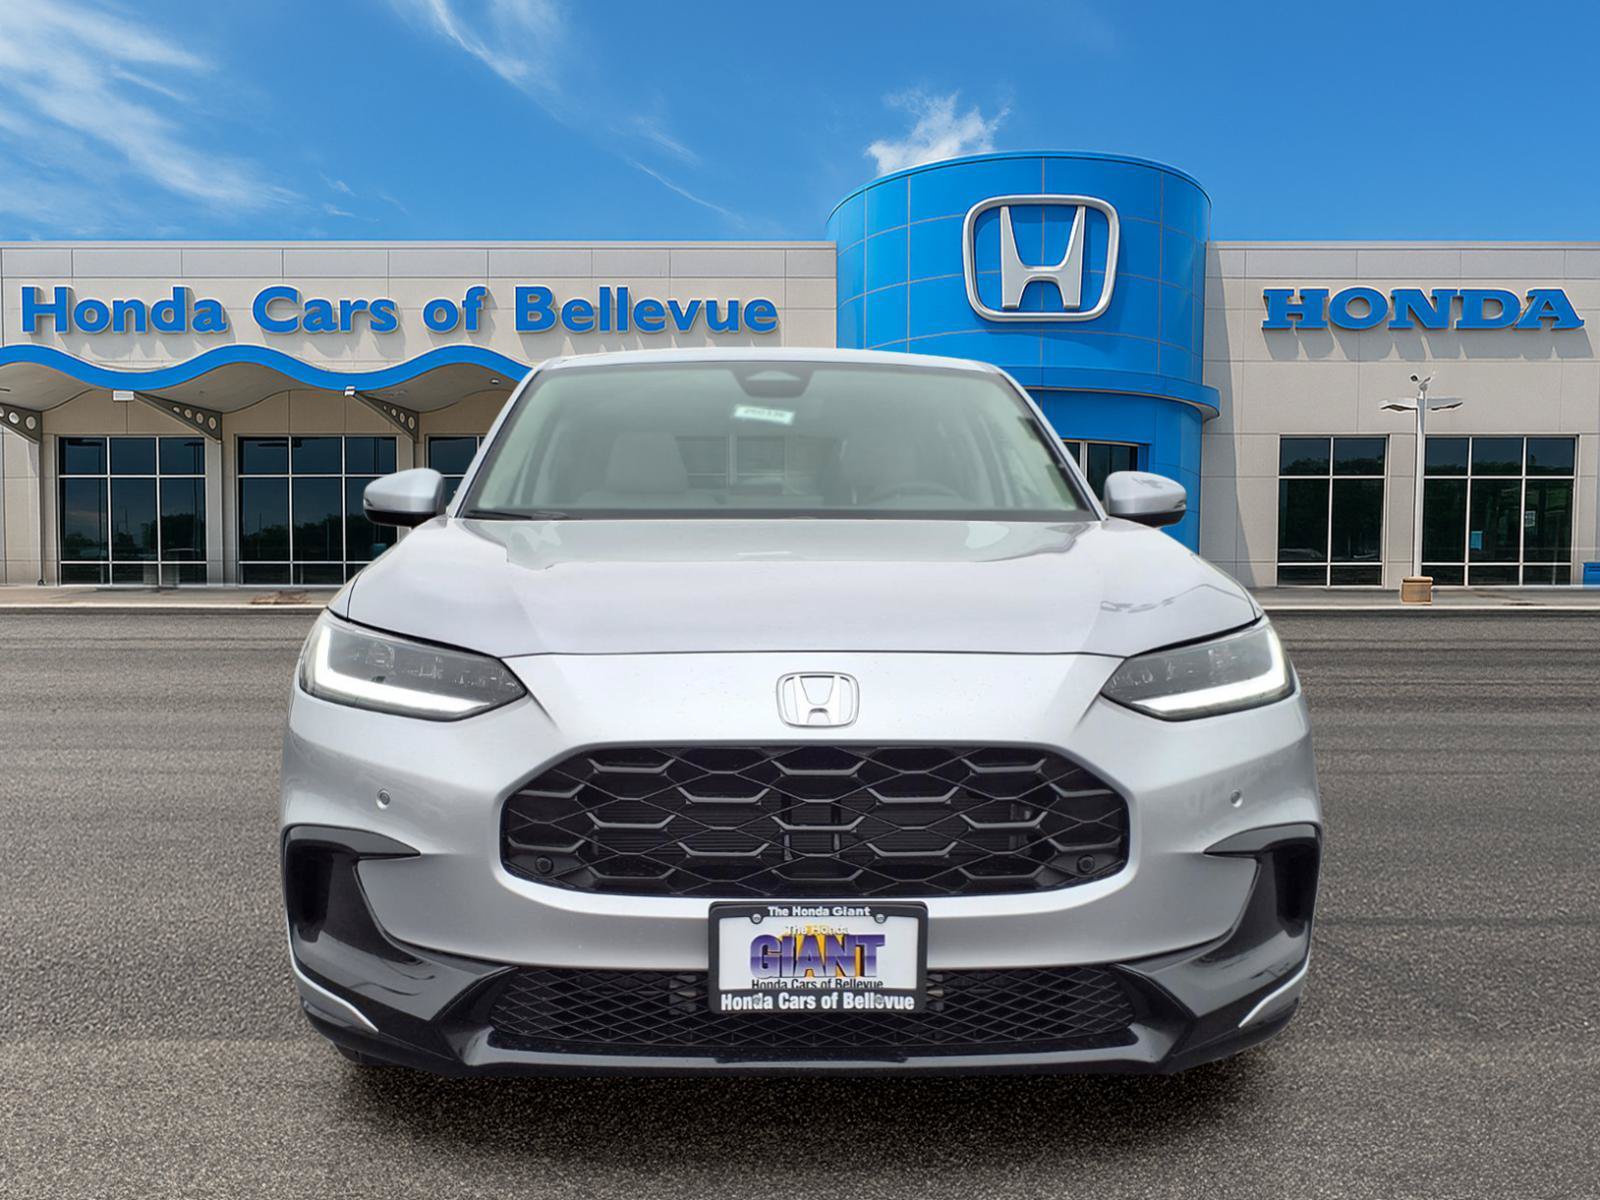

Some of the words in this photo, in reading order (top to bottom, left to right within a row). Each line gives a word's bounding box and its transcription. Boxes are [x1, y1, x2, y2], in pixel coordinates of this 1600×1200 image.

[20, 285, 229, 334] Honda
[252, 285, 399, 334] Cars
[421, 285, 488, 333] of
[513, 285, 779, 333] Bellevue
[1262, 285, 1585, 331] HONDA
[768, 906, 790, 917] The
[792, 906, 830, 917] Honda
[832, 906, 871, 917] Giant
[750, 934, 886, 978] GIANT
[751, 978, 788, 989] Honda
[791, 978, 817, 989] Cars
[820, 978, 832, 989] of
[836, 978, 884, 989] Bellevue
[721, 993, 773, 1011] Honda
[778, 993, 816, 1010] Cars
[821, 992, 839, 1010] of
[843, 992, 915, 1010] Bellevue
